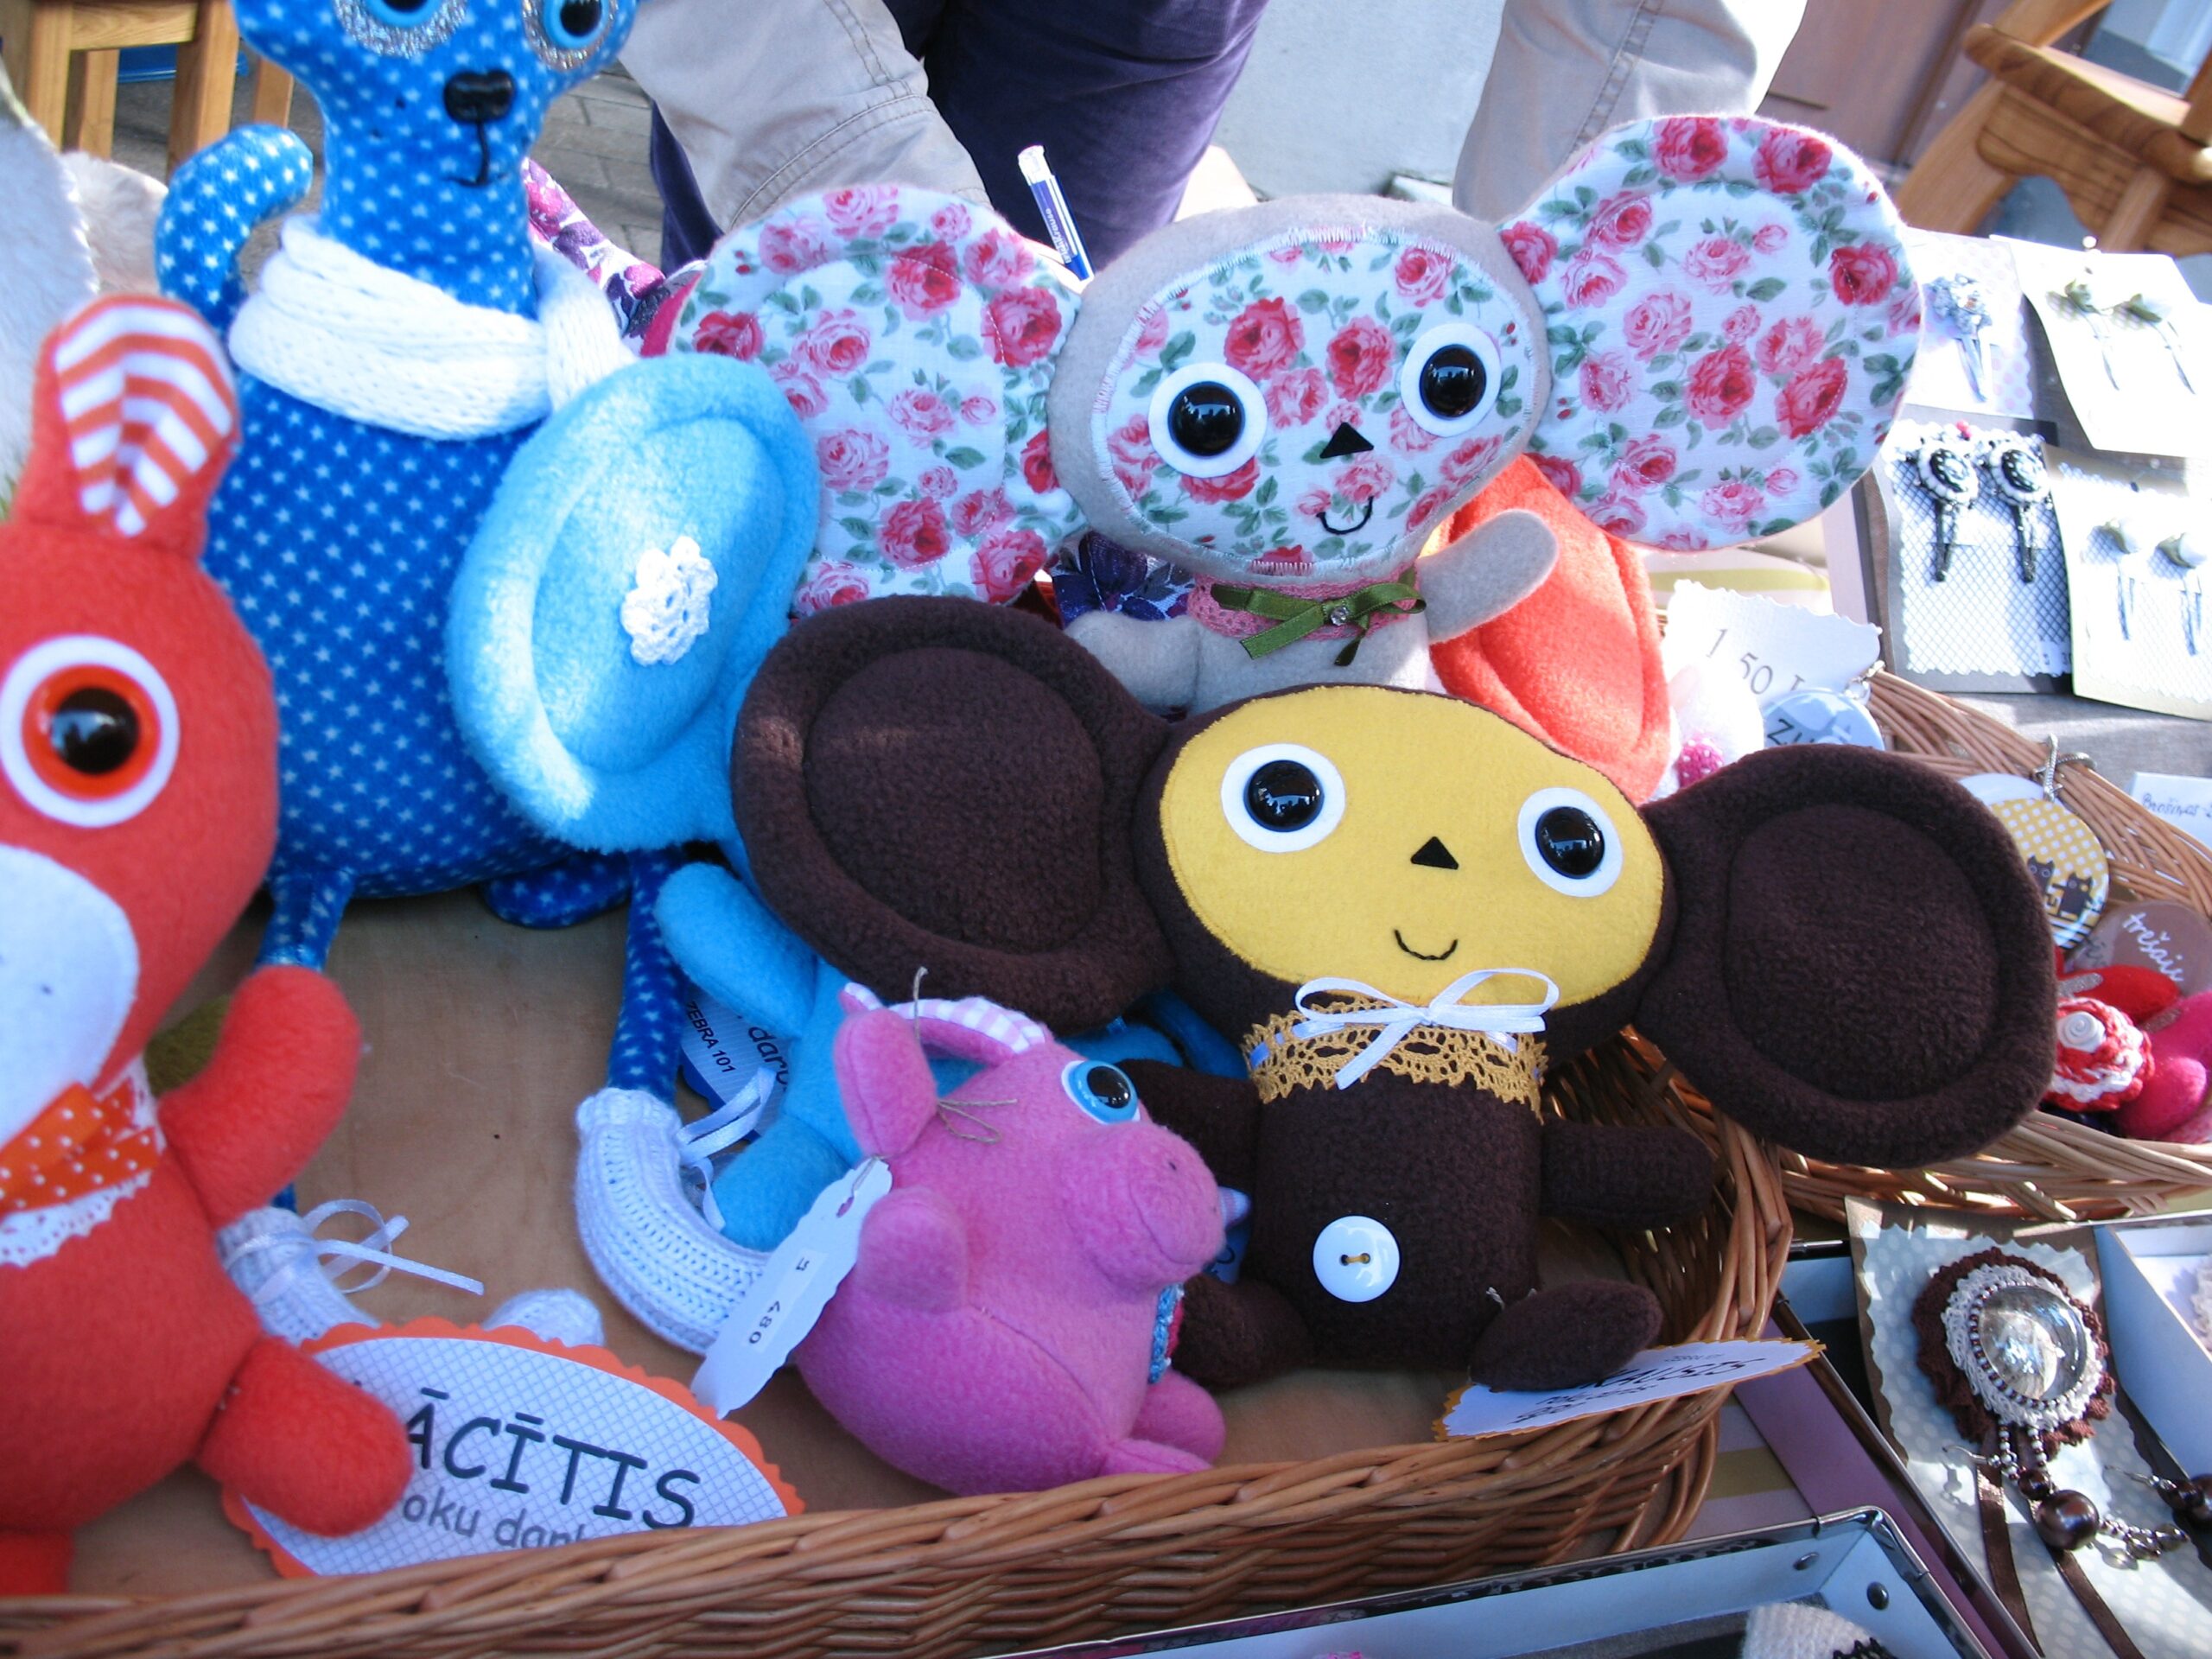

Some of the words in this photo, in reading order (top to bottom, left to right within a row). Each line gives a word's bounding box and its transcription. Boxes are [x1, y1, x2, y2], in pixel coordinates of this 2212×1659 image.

[712, 1050, 736, 1072] 101
[406, 1387, 702, 1529] ĀCĪTIS
[403, 1486, 480, 1538] oku
